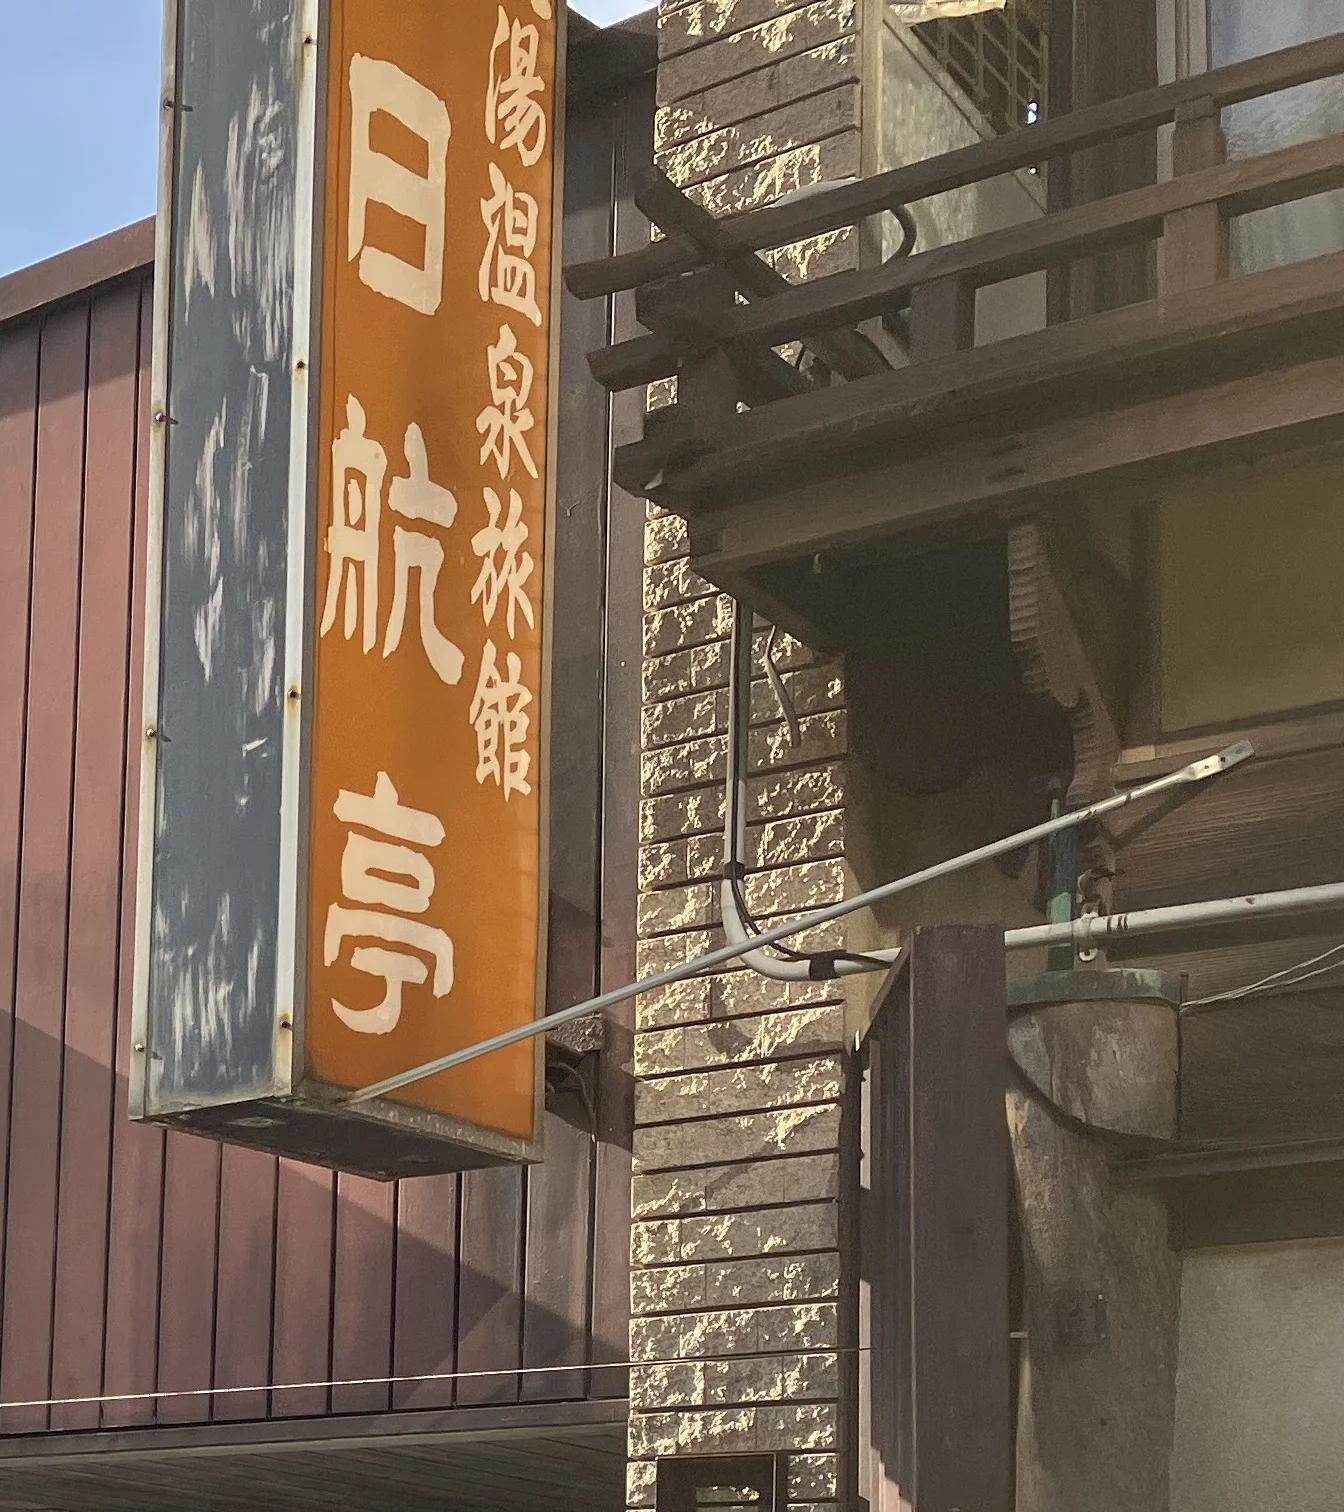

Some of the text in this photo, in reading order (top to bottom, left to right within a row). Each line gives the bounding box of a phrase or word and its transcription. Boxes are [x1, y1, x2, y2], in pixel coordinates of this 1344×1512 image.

[320, 52, 464, 1035] 日航亭
[469, 0, 551, 802] 湯温泉旅館
